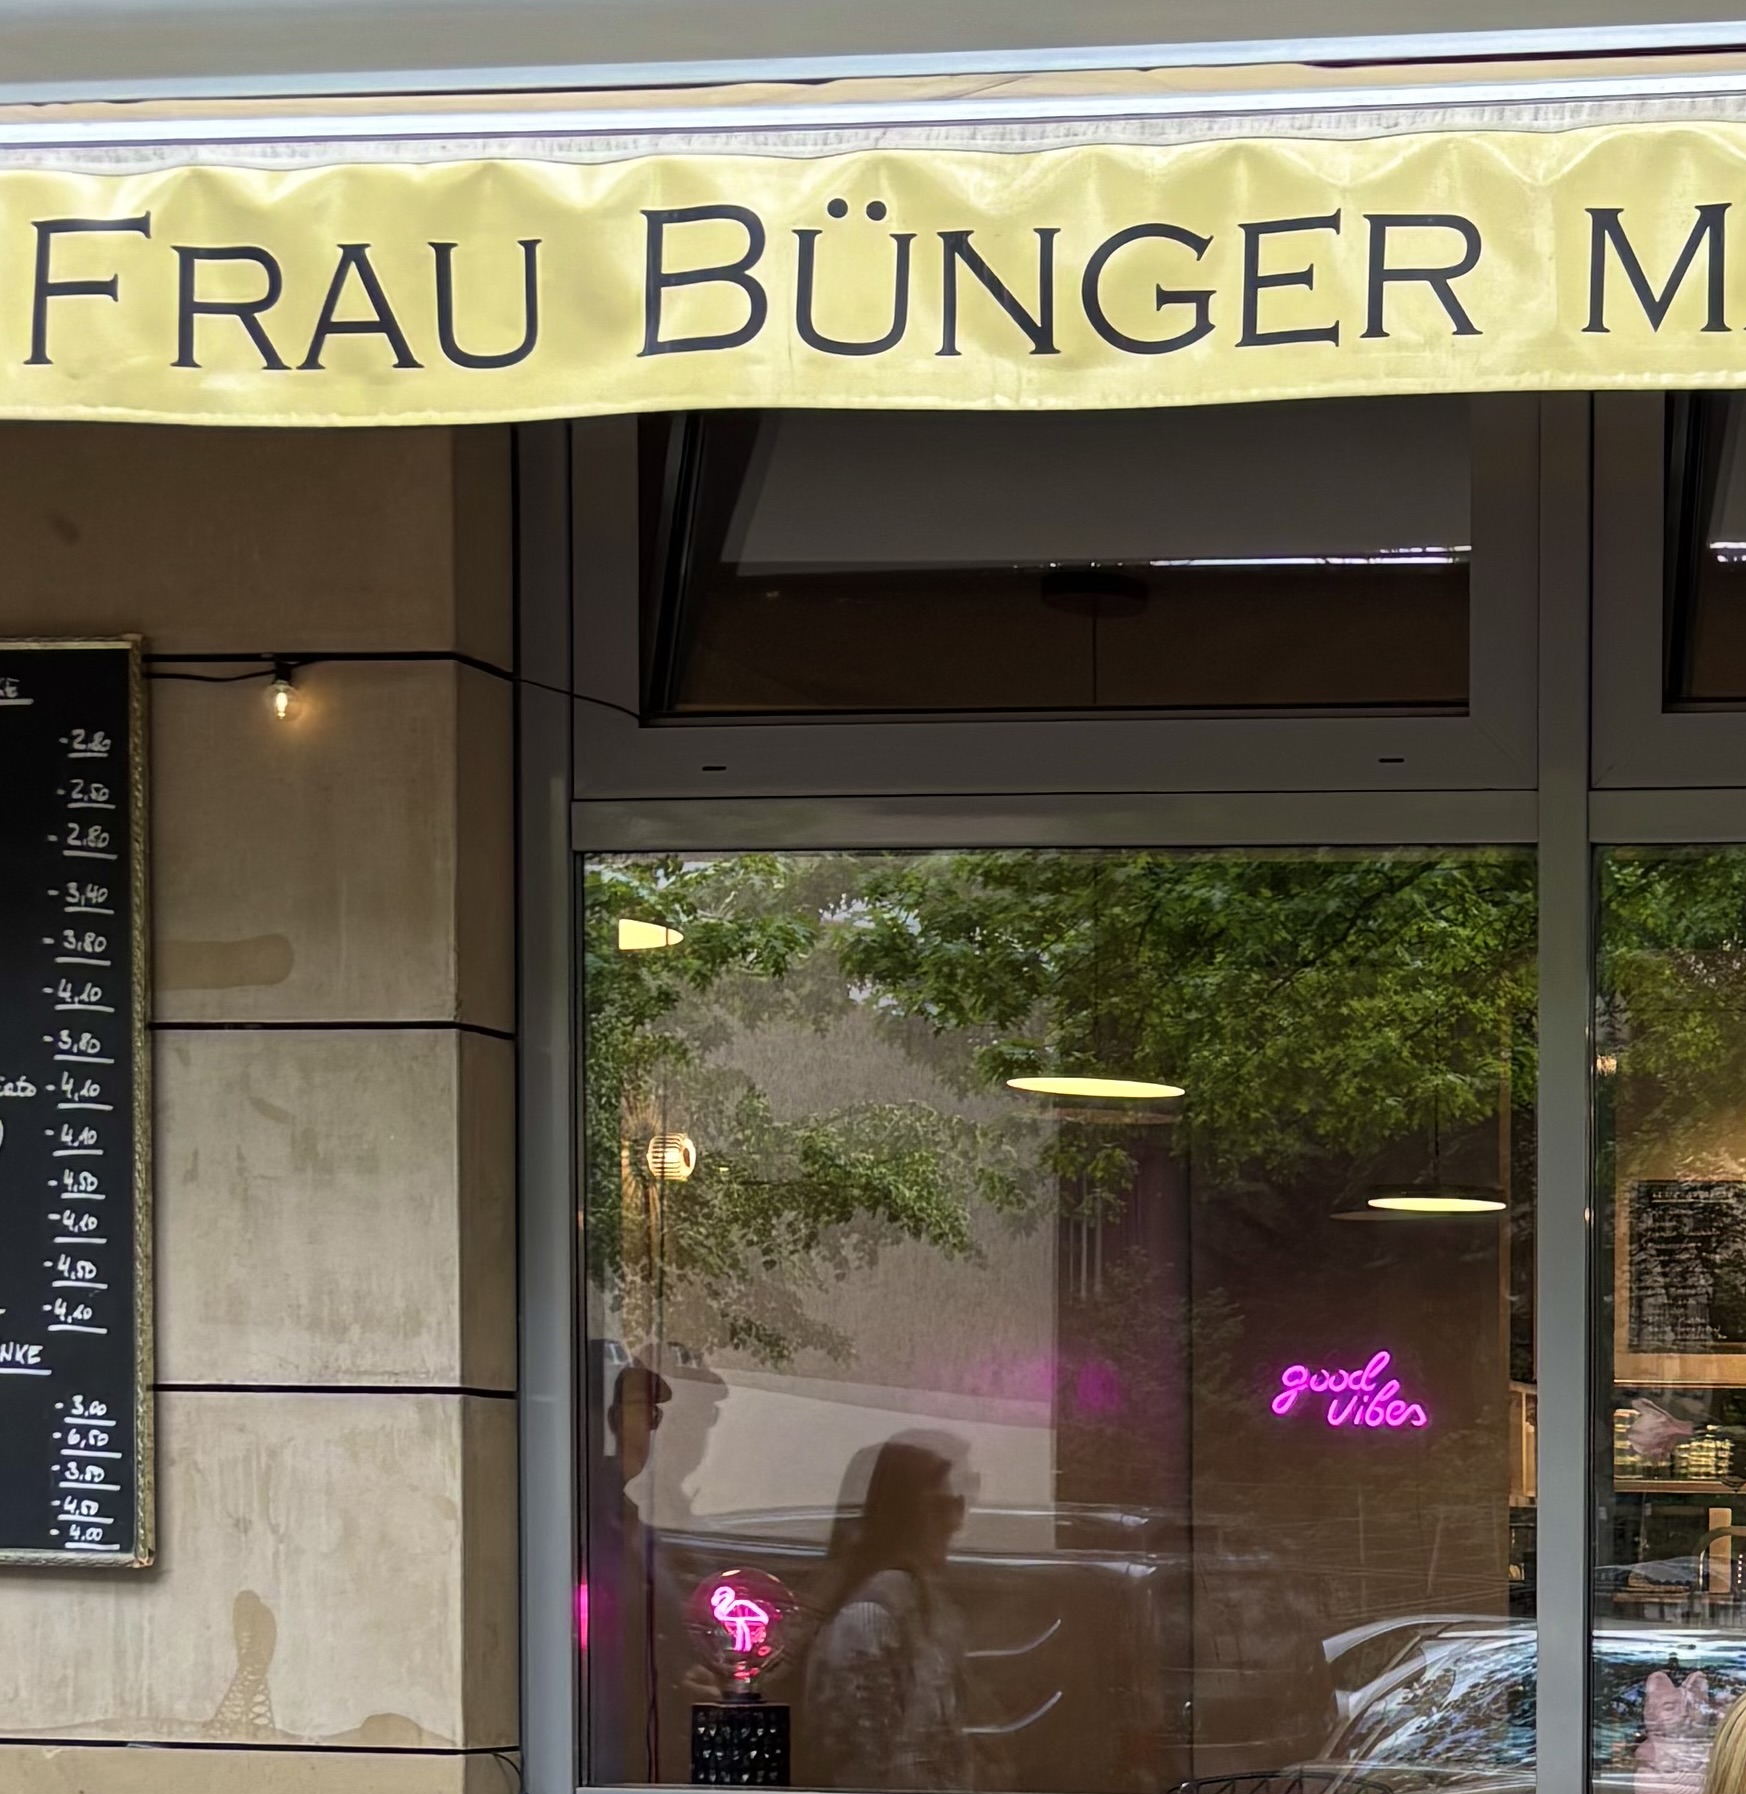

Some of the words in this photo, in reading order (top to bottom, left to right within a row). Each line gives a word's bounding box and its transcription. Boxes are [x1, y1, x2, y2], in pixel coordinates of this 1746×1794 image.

[23, 209, 543, 370] FRAU
[636, 197, 1485, 358] BÜNGER
[63, 929, 107, 953] 3,80
[57, 979, 102, 1005] 4,10
[57, 1029, 101, 1054] 3,80
[61, 1071, 101, 1101] 4,10
[1271, 1350, 1392, 1415] good
[70, 1394, 108, 1418] 3,00
[1327, 1379, 1428, 1427] vibes
